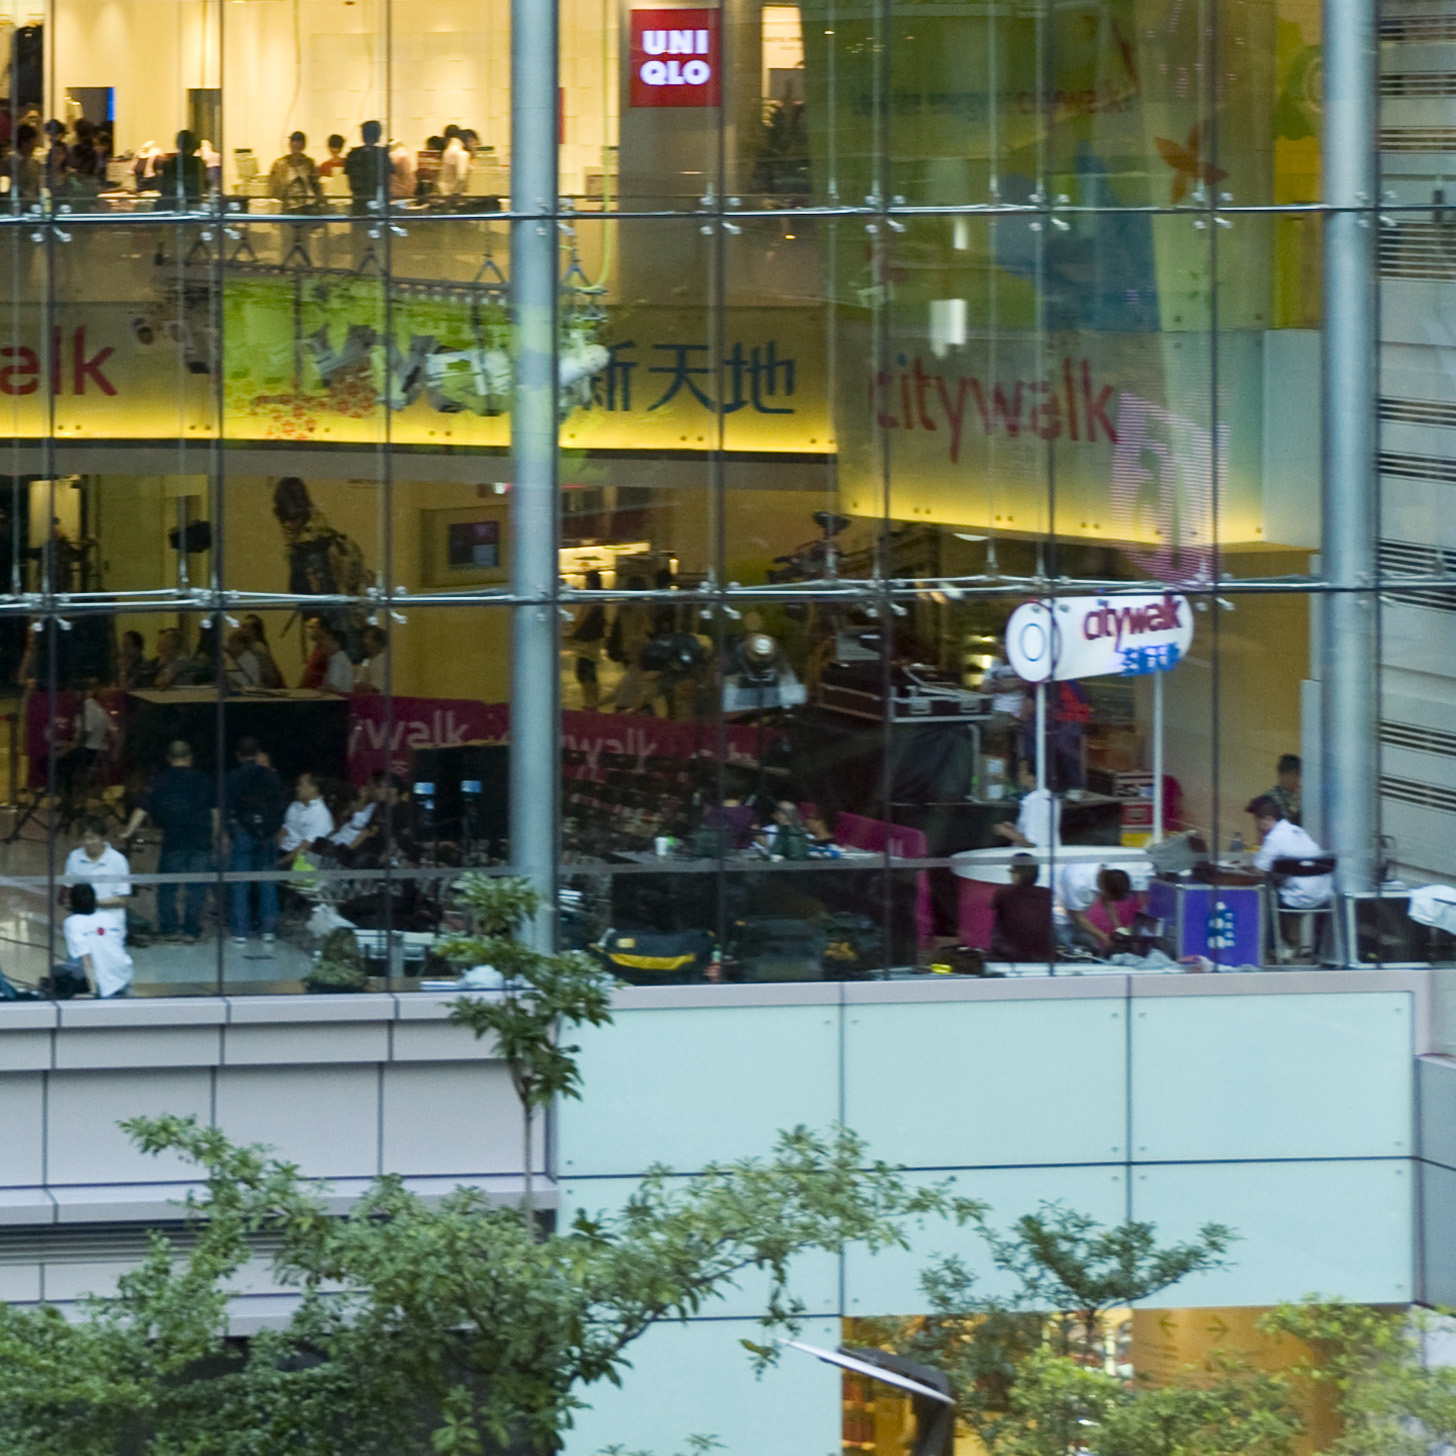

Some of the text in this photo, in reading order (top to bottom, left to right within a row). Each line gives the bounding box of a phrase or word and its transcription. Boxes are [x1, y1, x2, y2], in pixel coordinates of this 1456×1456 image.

[642, 30, 709, 55] UNI
[640, 59, 711, 86] QLO
[868, 354, 1120, 464] citywalk
